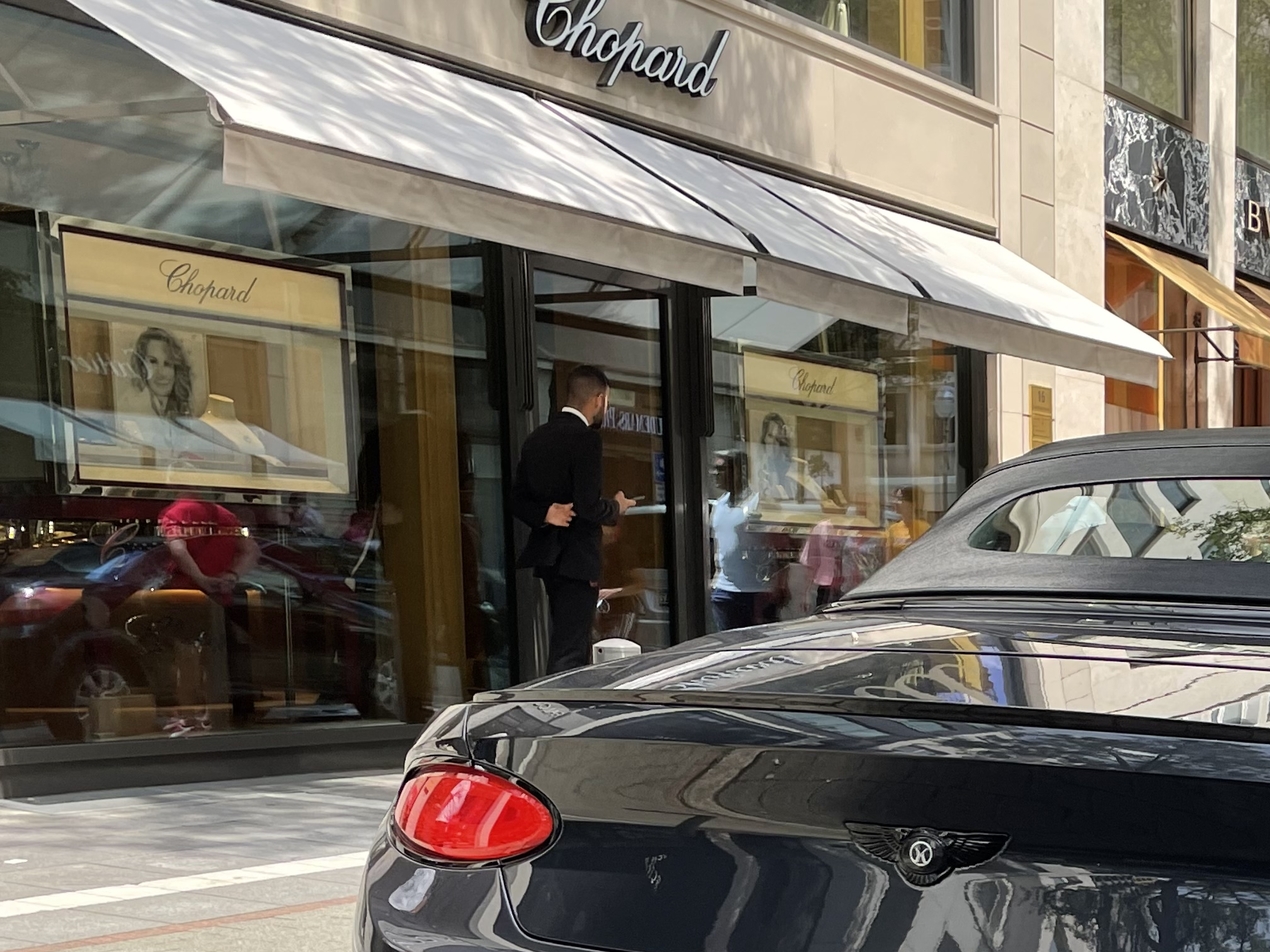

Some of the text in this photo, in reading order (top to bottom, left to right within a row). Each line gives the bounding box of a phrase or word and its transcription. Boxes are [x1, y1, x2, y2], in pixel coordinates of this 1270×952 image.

[527, 0, 730, 97] Chopard
[159, 259, 258, 304] Chopard
[789, 364, 838, 396] Chopard
